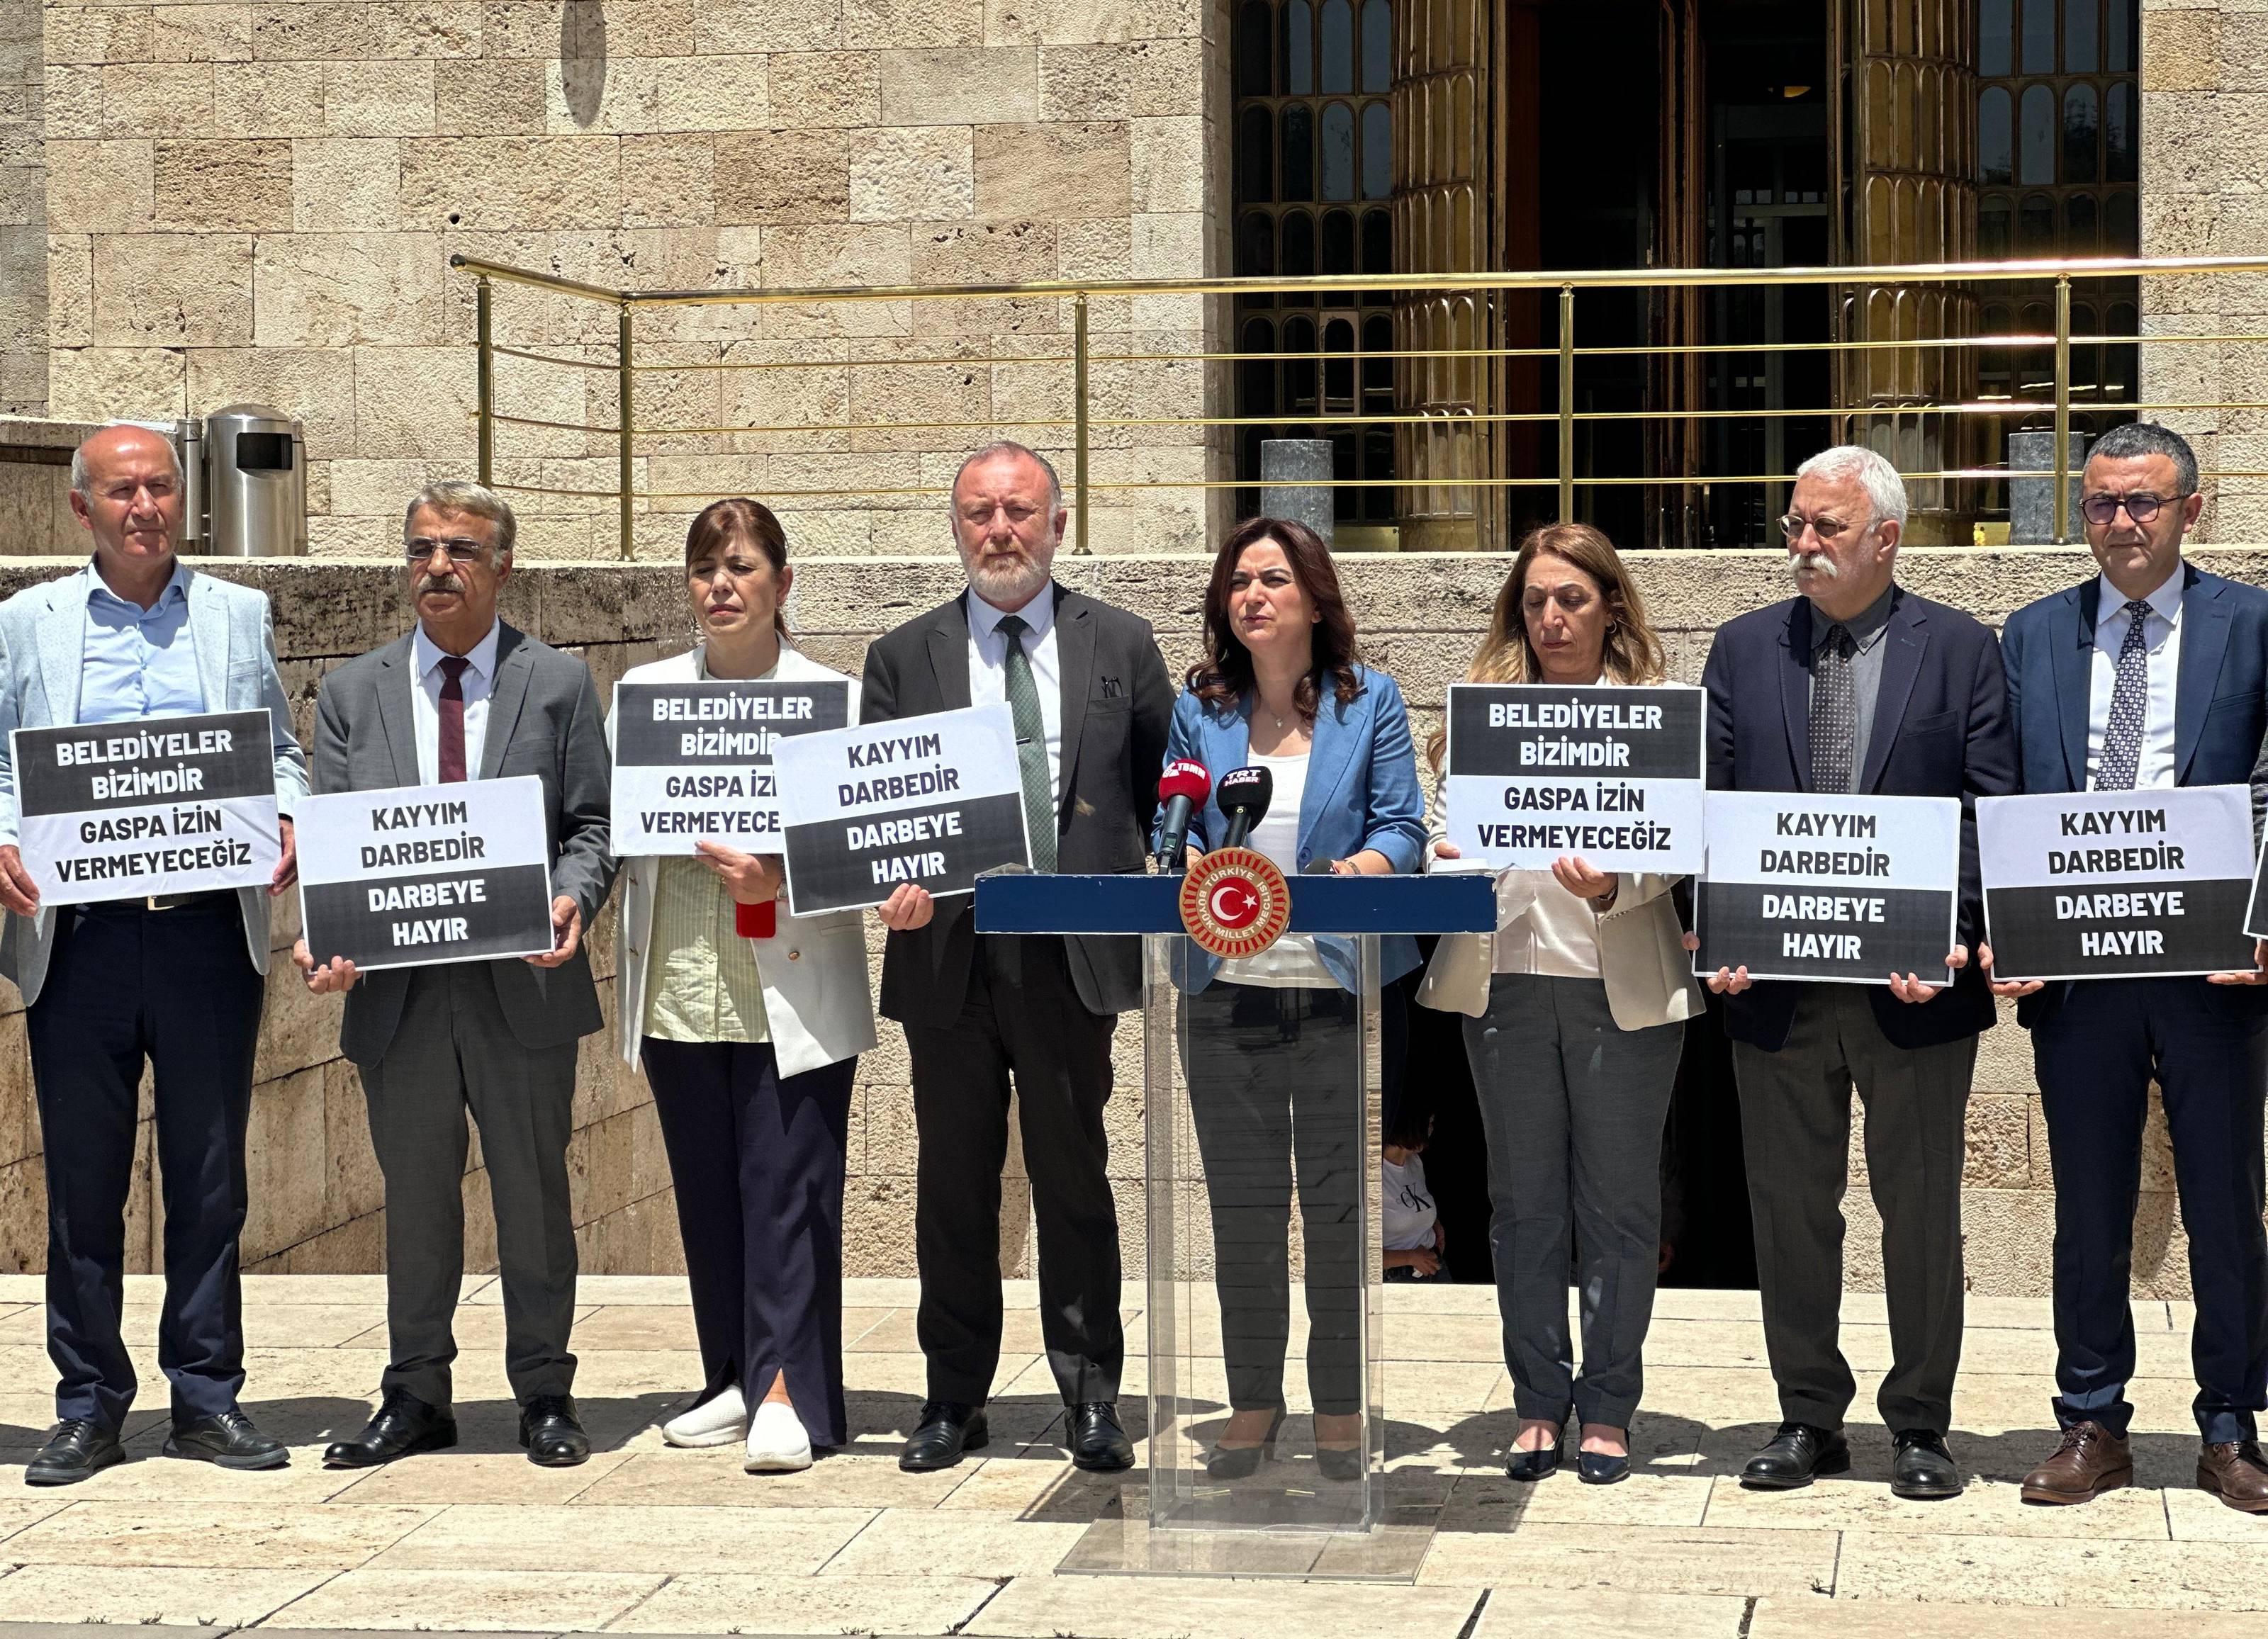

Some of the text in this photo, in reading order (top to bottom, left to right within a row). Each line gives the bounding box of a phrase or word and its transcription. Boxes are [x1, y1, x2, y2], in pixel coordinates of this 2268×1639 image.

[653, 692, 813, 721] BELEDİYELER
[1489, 697, 1663, 730] BELEDİYELER
[57, 729, 232, 767] BELEDİYELER
[847, 733, 941, 769] KAYYIM
[1520, 735, 1630, 767] BİZİMDİR
[92, 762, 204, 799] BİZİMDİR
[838, 763, 960, 807] DARBEDİR
[1177, 762, 1206, 779] TBMM
[1224, 776, 1259, 787] HABER
[1227, 770, 1261, 779] TRT
[666, 776, 744, 798] GASPA
[1504, 782, 1644, 812] GASPA İZİN
[80, 805, 222, 844] GASPA İZİN
[371, 801, 468, 831] KAYYIM
[640, 811, 781, 833] VERMEYECE
[846, 811, 962, 851] DARBEYE
[1777, 812, 1876, 838] KAYYIM
[2060, 809, 2167, 836] KAYYIM
[361, 830, 485, 869] DARBEDİR
[1477, 820, 1671, 850] VERMEYECEĞİZ
[55, 841, 252, 883] VERMEYECEĞİZ
[871, 851, 947, 884] HAYIR
[1761, 846, 1890, 877] DARBEDİR
[2048, 840, 2185, 874] DARBEDİR
[1205, 867, 1254, 886] TÜRKİYE
[368, 879, 486, 912] DARBEYE
[1762, 894, 1885, 923] DARBEYE
[2055, 891, 2185, 920] DARBEYE
[1198, 890, 1215, 929] BÜYÜK
[1215, 925, 1255, 939] MİLLET
[392, 918, 468, 947] HAYIR
[1783, 933, 1862, 959] HAYIR
[2081, 930, 2165, 957] HAYIR
